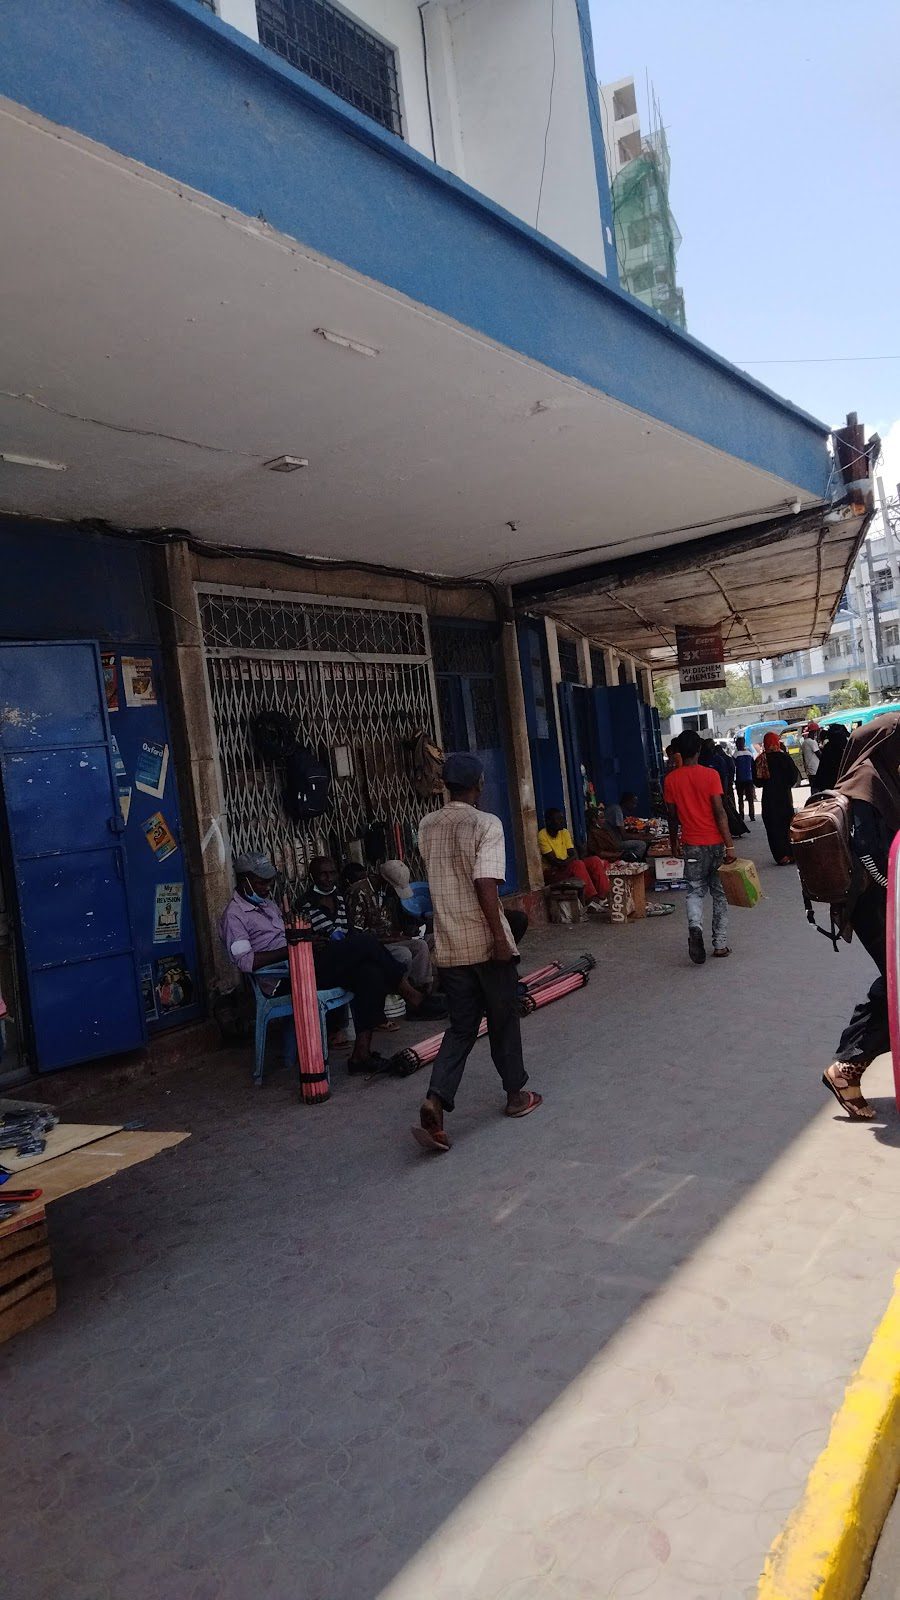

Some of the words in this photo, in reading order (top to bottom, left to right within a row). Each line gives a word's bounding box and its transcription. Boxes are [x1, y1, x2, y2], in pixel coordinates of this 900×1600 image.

[683, 671, 721, 682] CHEMIST
[142, 743, 164, 757] Oxford
[157, 896, 181, 904] REVISION
[611, 877, 625, 922] UGORO
